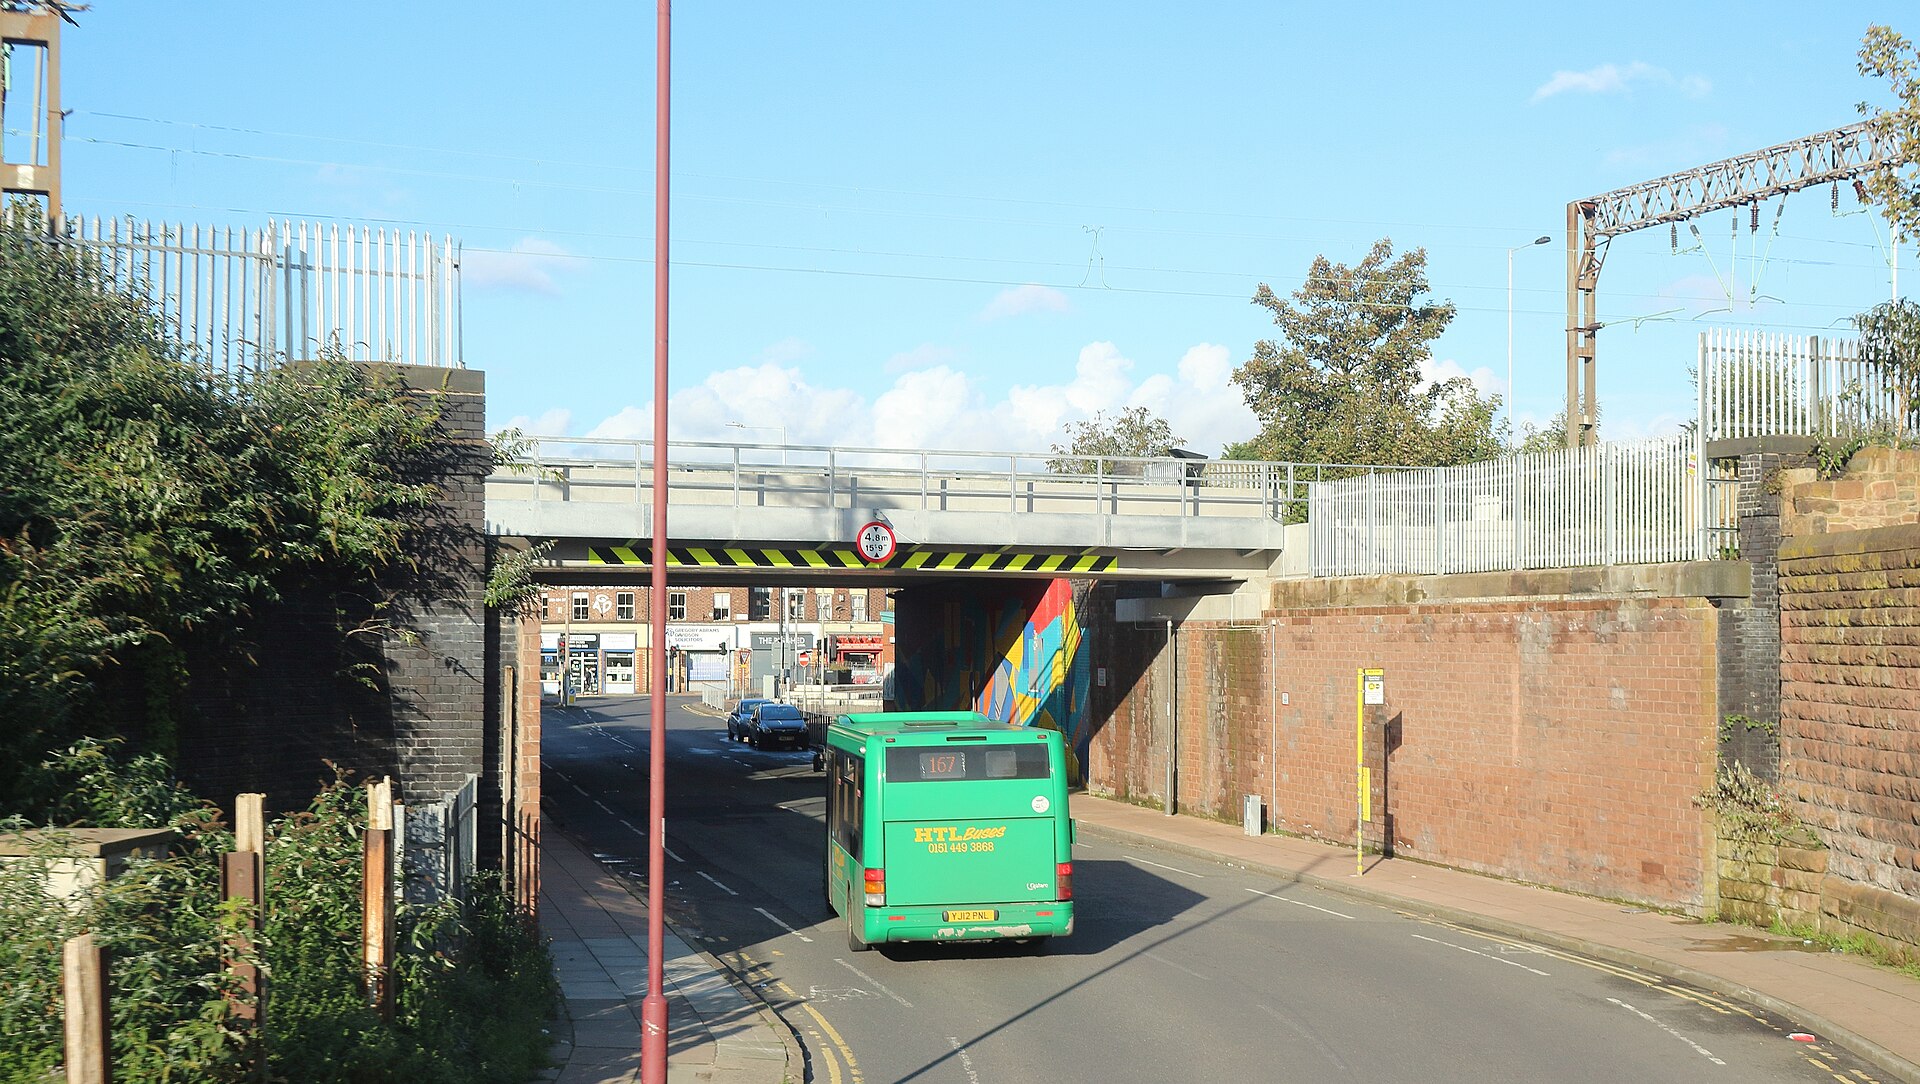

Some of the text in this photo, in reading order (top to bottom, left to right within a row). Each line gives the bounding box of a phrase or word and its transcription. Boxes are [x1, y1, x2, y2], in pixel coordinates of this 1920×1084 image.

[758, 636, 773, 645] THE
[929, 756, 956, 773] 167
[914, 827, 963, 843] HTL
[928, 842, 995, 853] 0151 449 3868
[951, 910, 989, 921] YJ12 PNL
